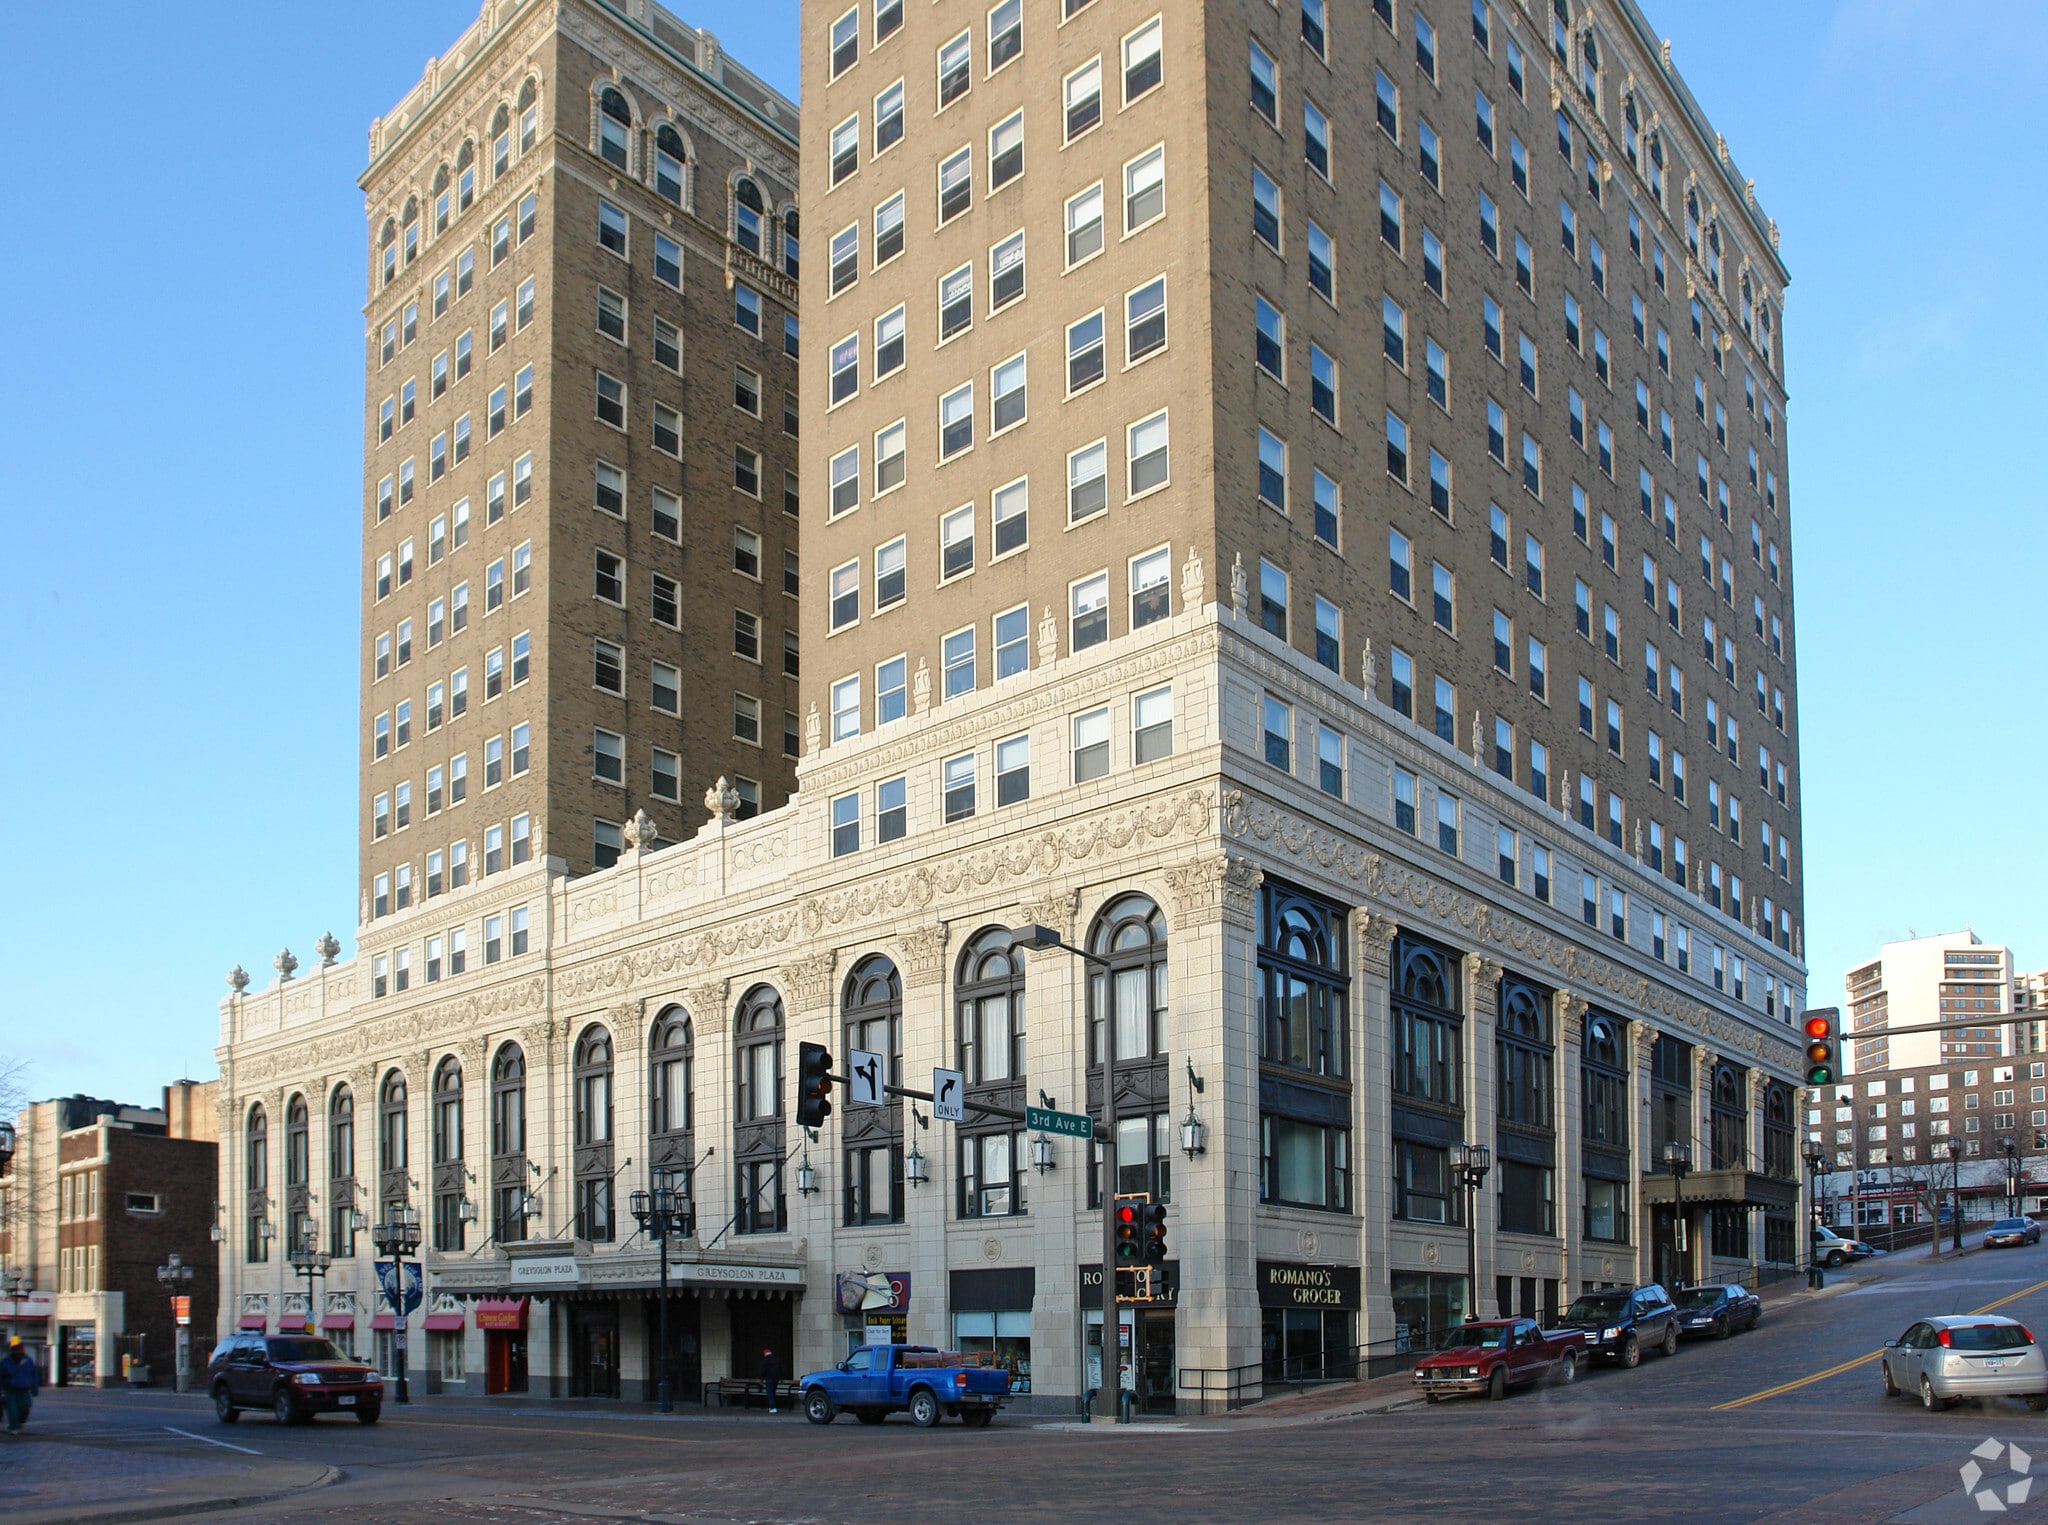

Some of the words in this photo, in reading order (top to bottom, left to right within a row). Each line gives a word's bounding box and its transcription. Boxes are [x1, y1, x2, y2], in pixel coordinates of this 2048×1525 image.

[938, 1104, 960, 1117] ONLY
[1031, 1112, 1050, 1127] 3rd
[1055, 1117, 1076, 1131] Ave
[1080, 1120, 1088, 1133] E
[517, 1265, 552, 1276] GREYSOLON
[554, 1264, 574, 1274] PLAZA
[697, 1267, 755, 1280] GREYSOLON
[758, 1270, 786, 1281] PLAZA
[1269, 1268, 1332, 1287] ROMANO'S
[1292, 1287, 1342, 1304] GROCER
